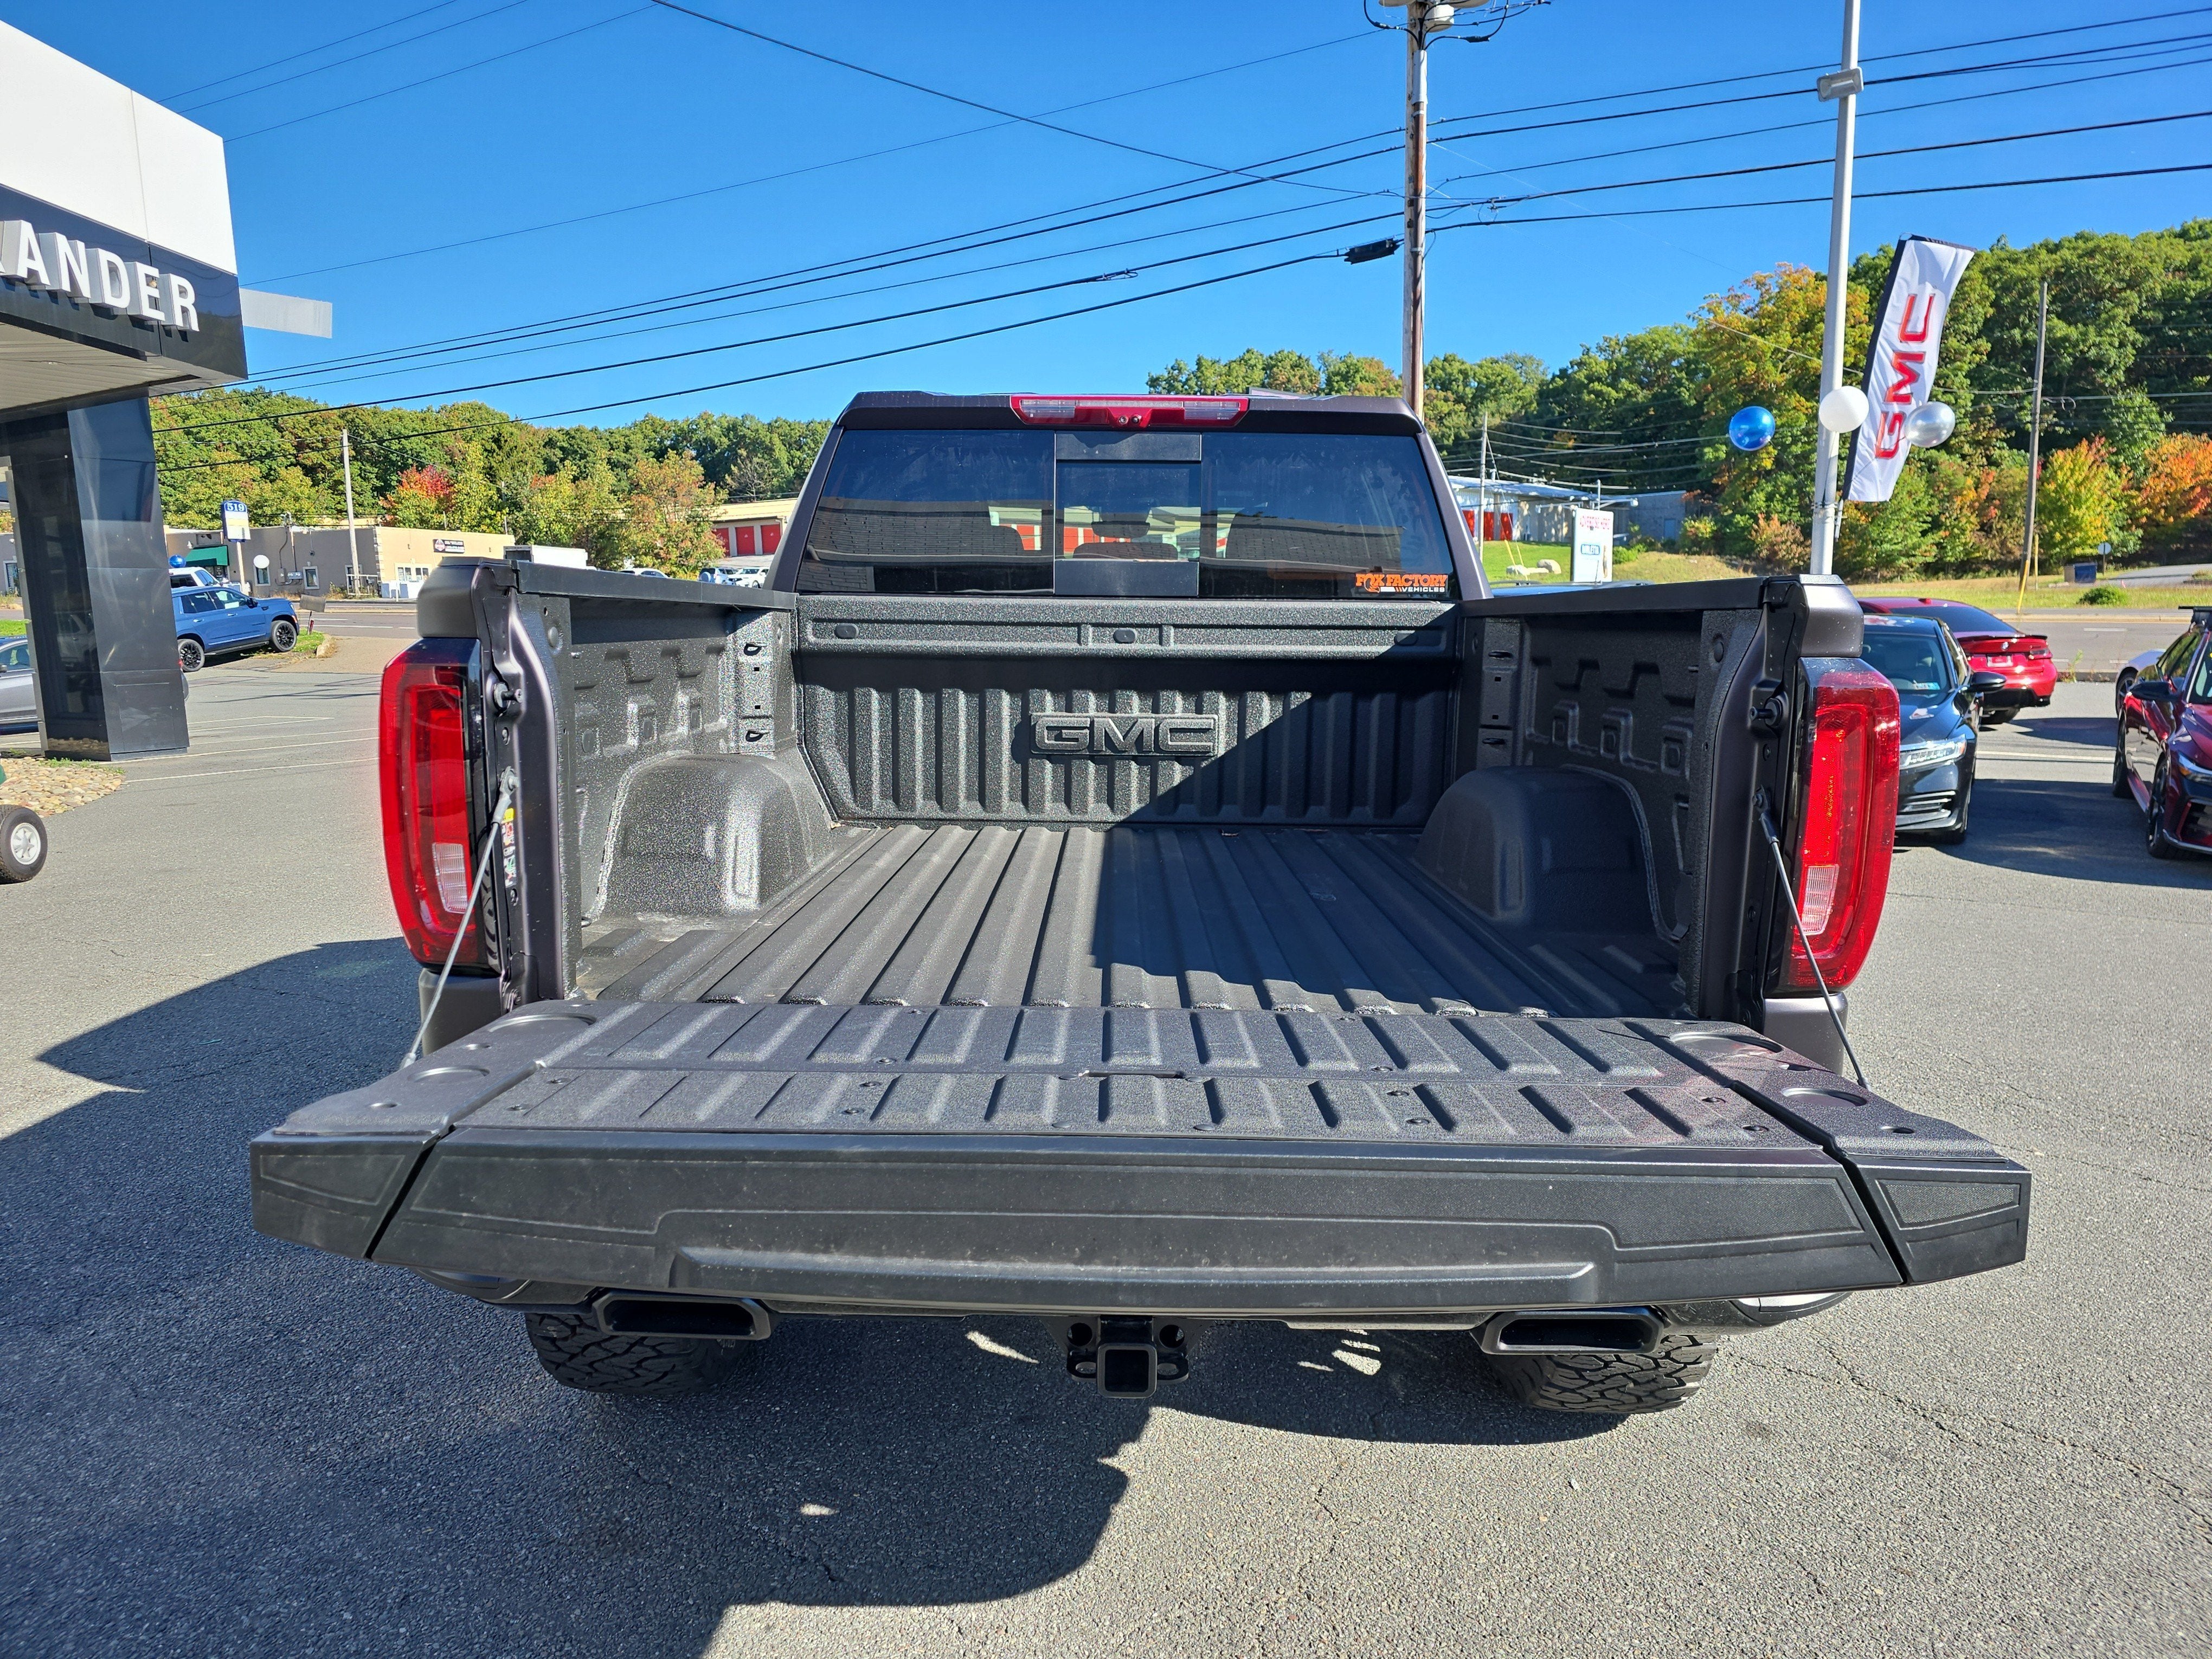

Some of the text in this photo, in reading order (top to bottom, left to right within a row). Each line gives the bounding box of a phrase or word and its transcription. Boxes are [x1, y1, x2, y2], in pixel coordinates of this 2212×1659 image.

[0, 220, 200, 332] ANDER
[1874, 293, 1935, 459] GMC
[227, 503, 245, 511] 519
[1356, 573, 1448, 593] FOX FACTORY
[1035, 717, 1214, 752] GMC
